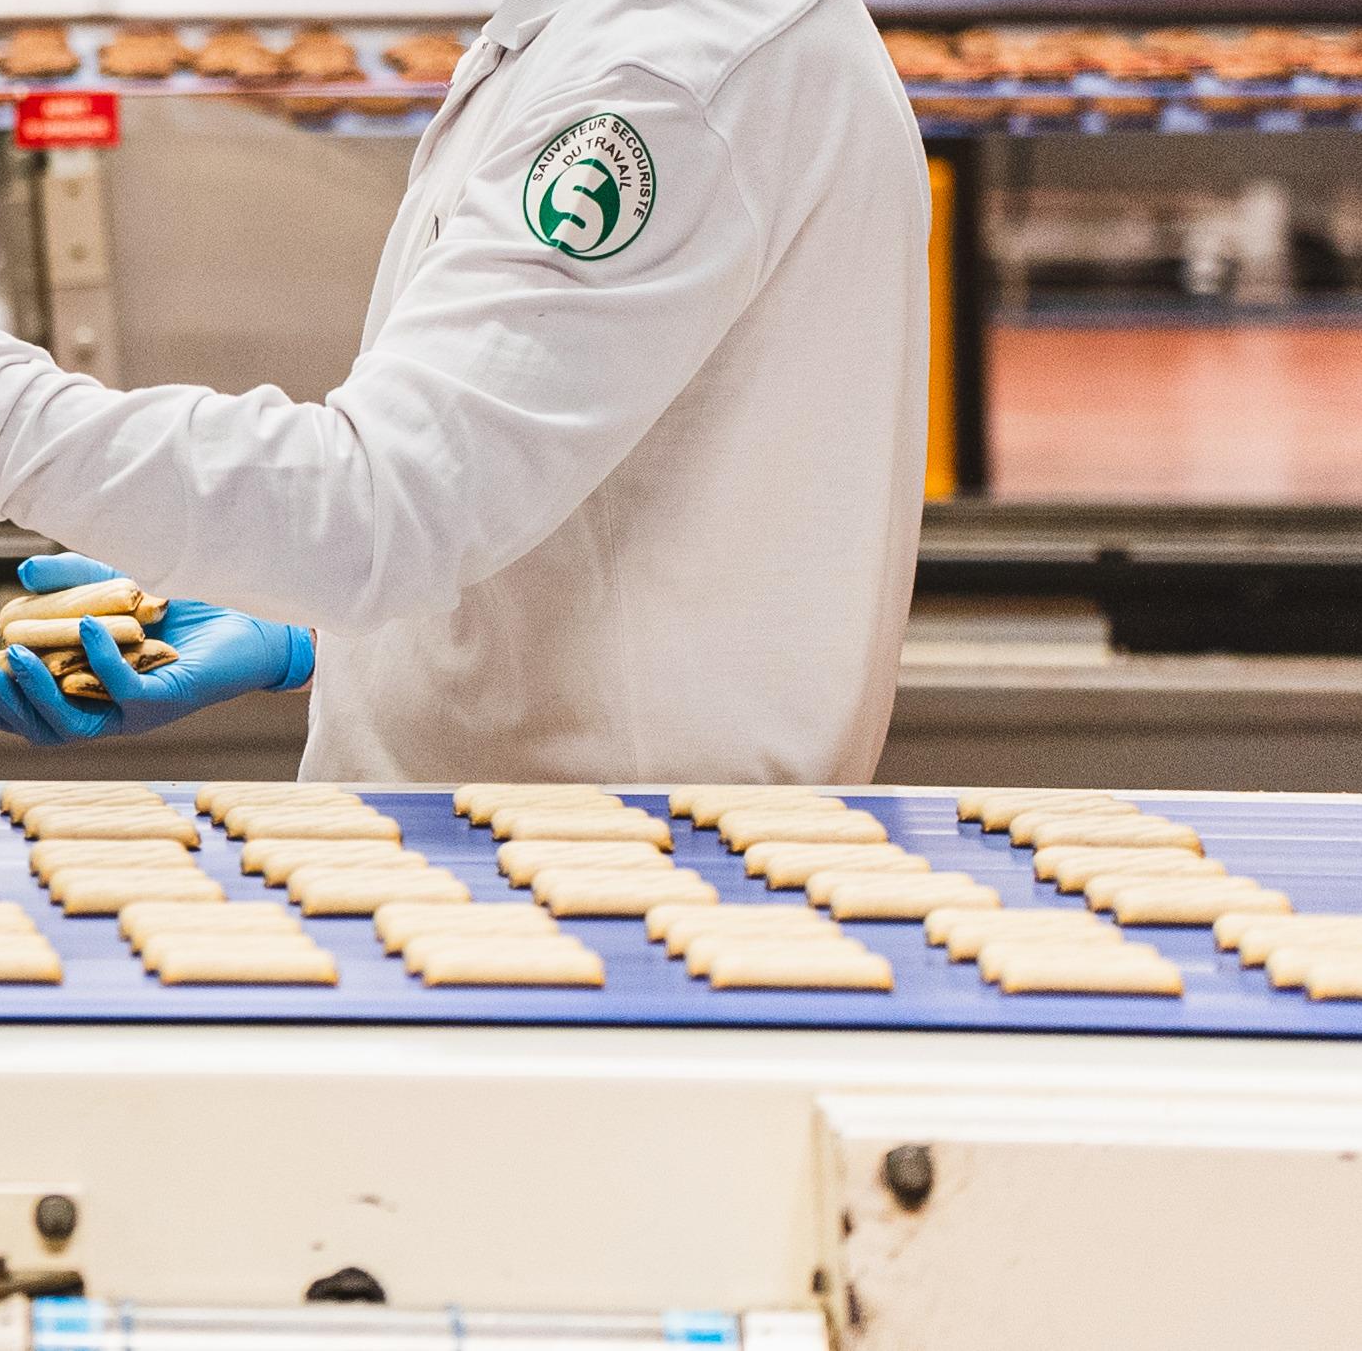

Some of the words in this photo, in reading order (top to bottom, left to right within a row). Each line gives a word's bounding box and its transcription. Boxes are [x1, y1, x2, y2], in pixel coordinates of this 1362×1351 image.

[532, 117, 607, 182] SAUVETEUR
[610, 120, 651, 220] SECOURISTE
[562, 146, 582, 167] DU
[585, 136, 632, 192] TRAVAIL
